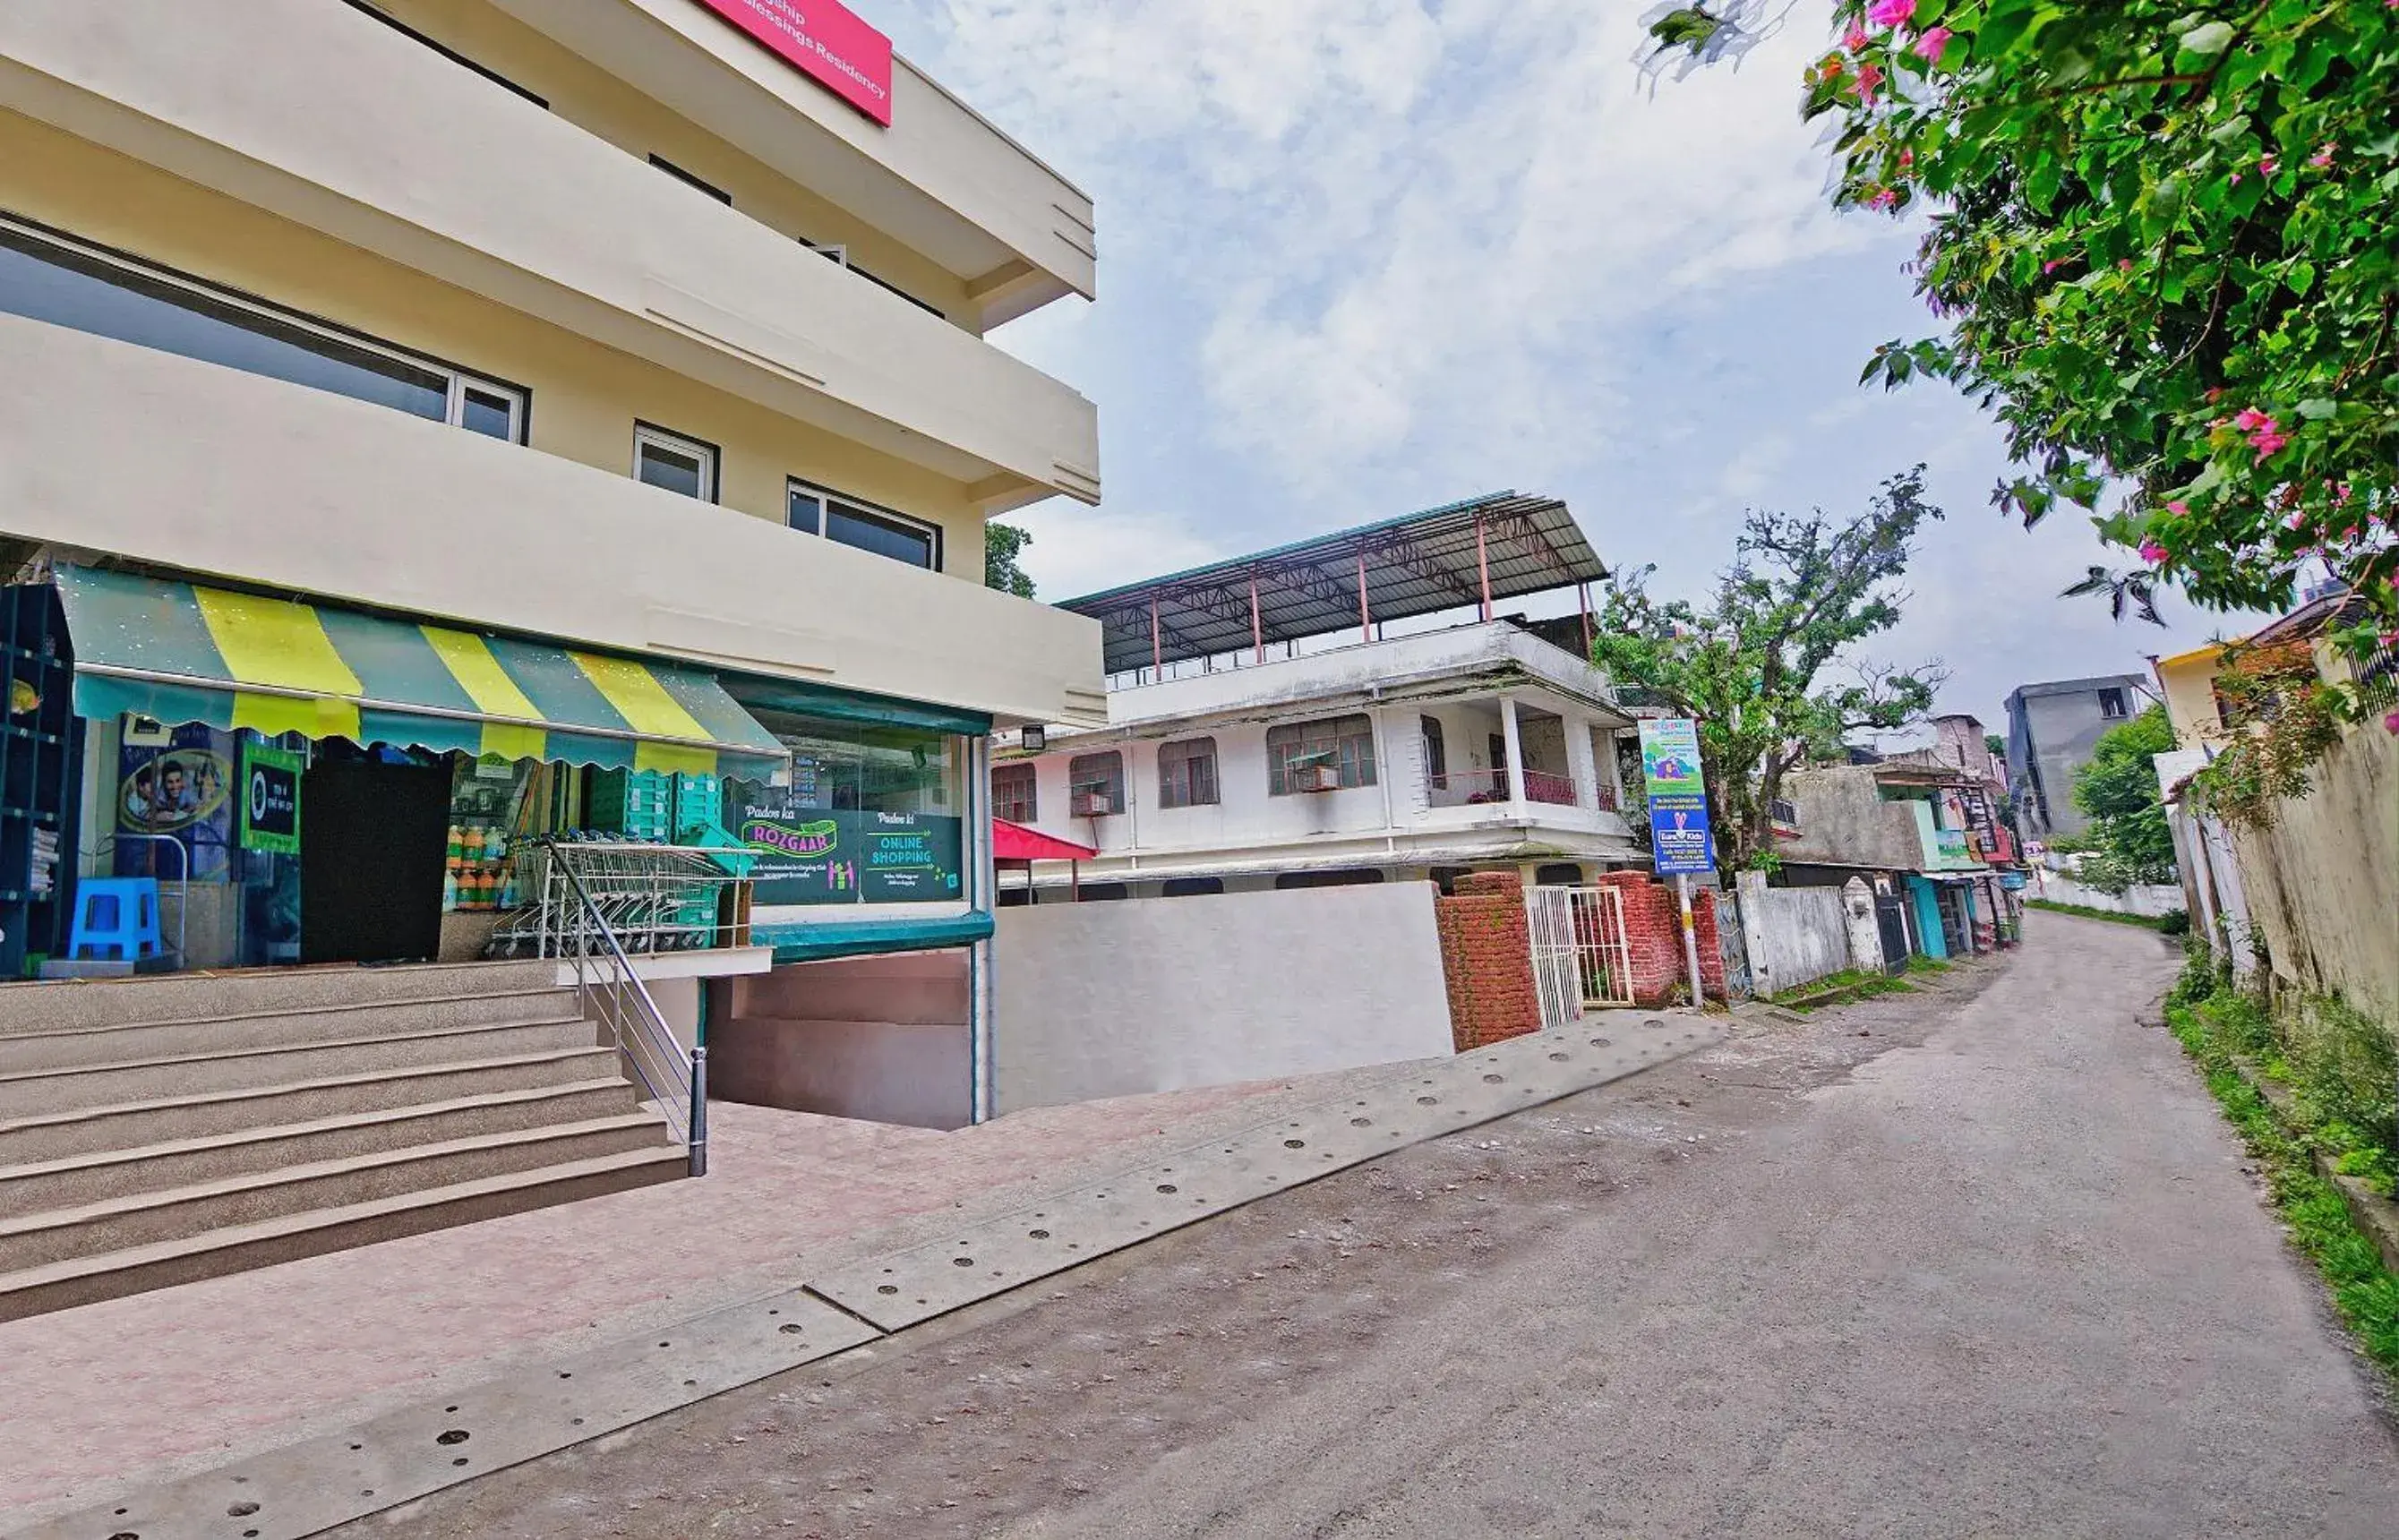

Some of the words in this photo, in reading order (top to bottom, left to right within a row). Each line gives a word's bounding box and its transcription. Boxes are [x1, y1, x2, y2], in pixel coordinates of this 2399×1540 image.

[816, 42, 886, 99] Residency
[745, 805, 780, 819] Pados
[781, 806, 795, 820] ka
[754, 826, 828, 851] ROZGAAR
[880, 837, 923, 850] ONLINE
[872, 851, 932, 864] SHOPPING
